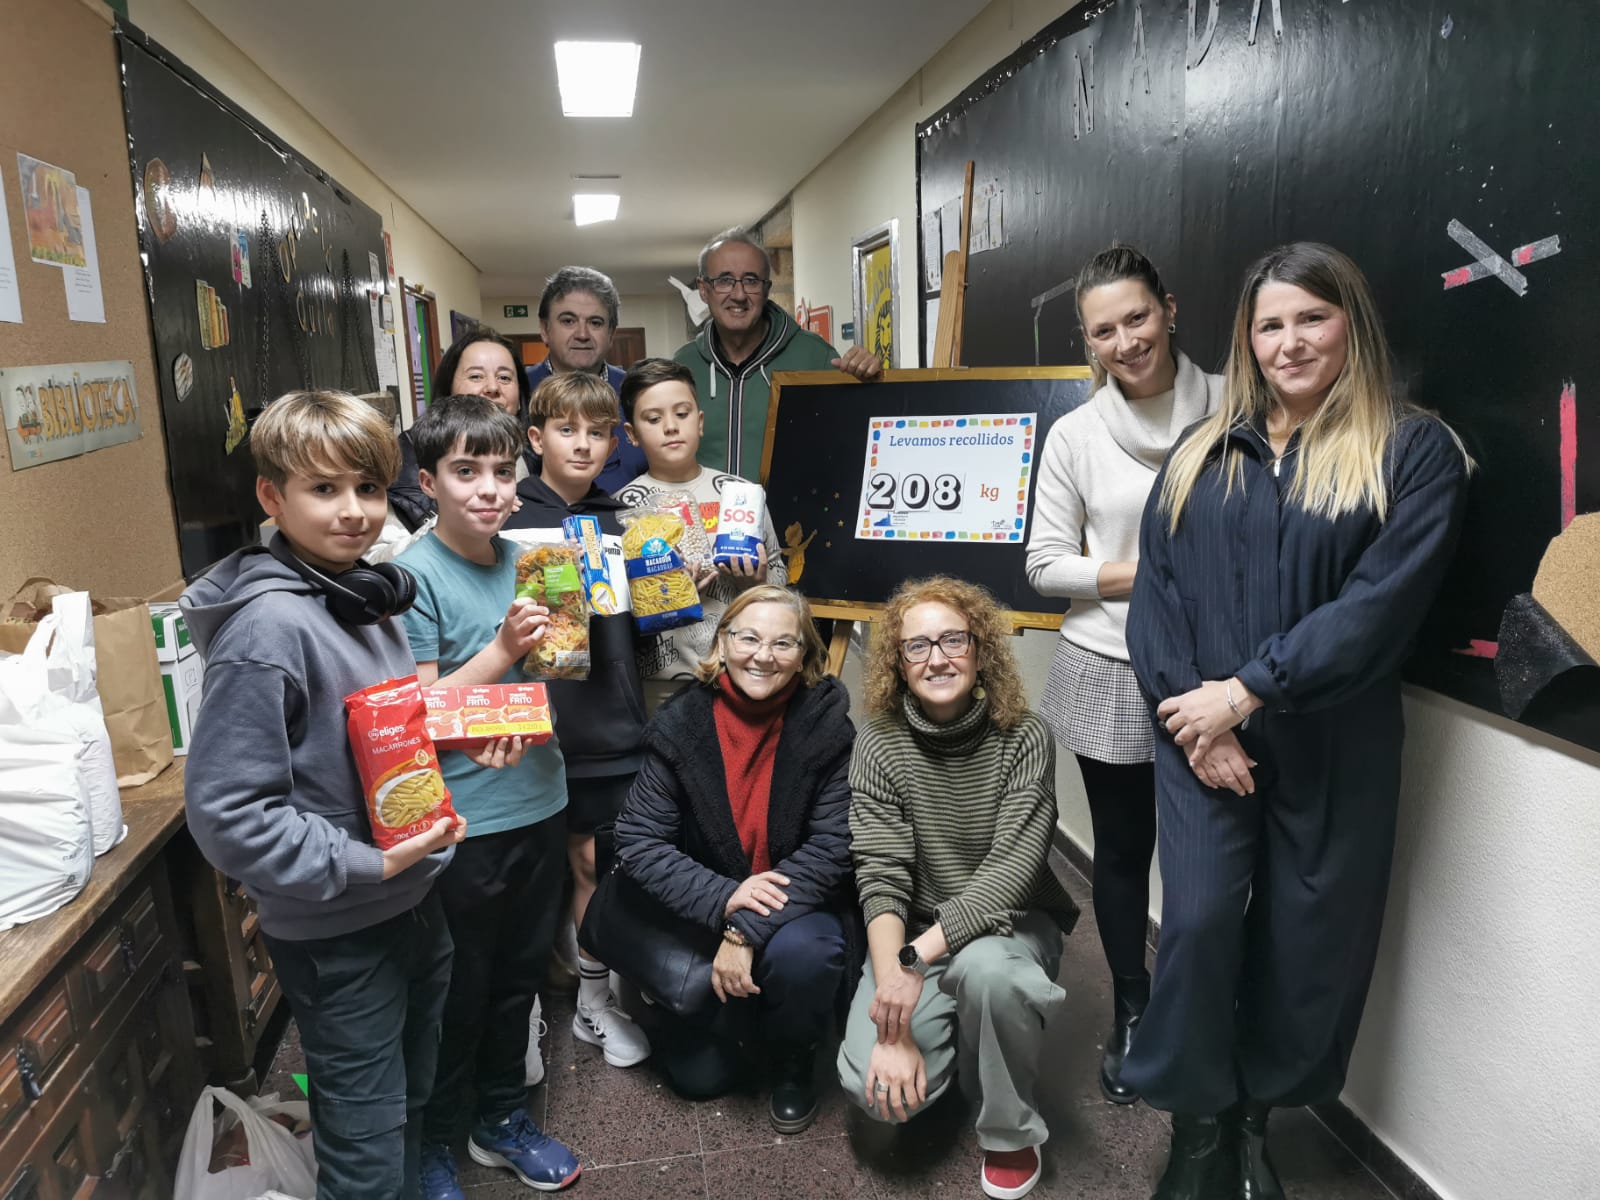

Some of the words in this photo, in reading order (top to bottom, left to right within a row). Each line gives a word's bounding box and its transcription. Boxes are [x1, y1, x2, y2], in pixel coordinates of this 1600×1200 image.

[38, 376, 137, 441] BIBLIOTECA
[889, 434, 946, 447] Levamos
[949, 432, 1014, 446] recollidos
[867, 472, 962, 511] 208
[980, 483, 999, 501] kg
[723, 508, 755, 524] SOS
[466, 698, 490, 706] FRITO
[509, 696, 533, 705] FRITO
[379, 724, 405, 737] eliges
[372, 736, 421, 754] MACARRONES
